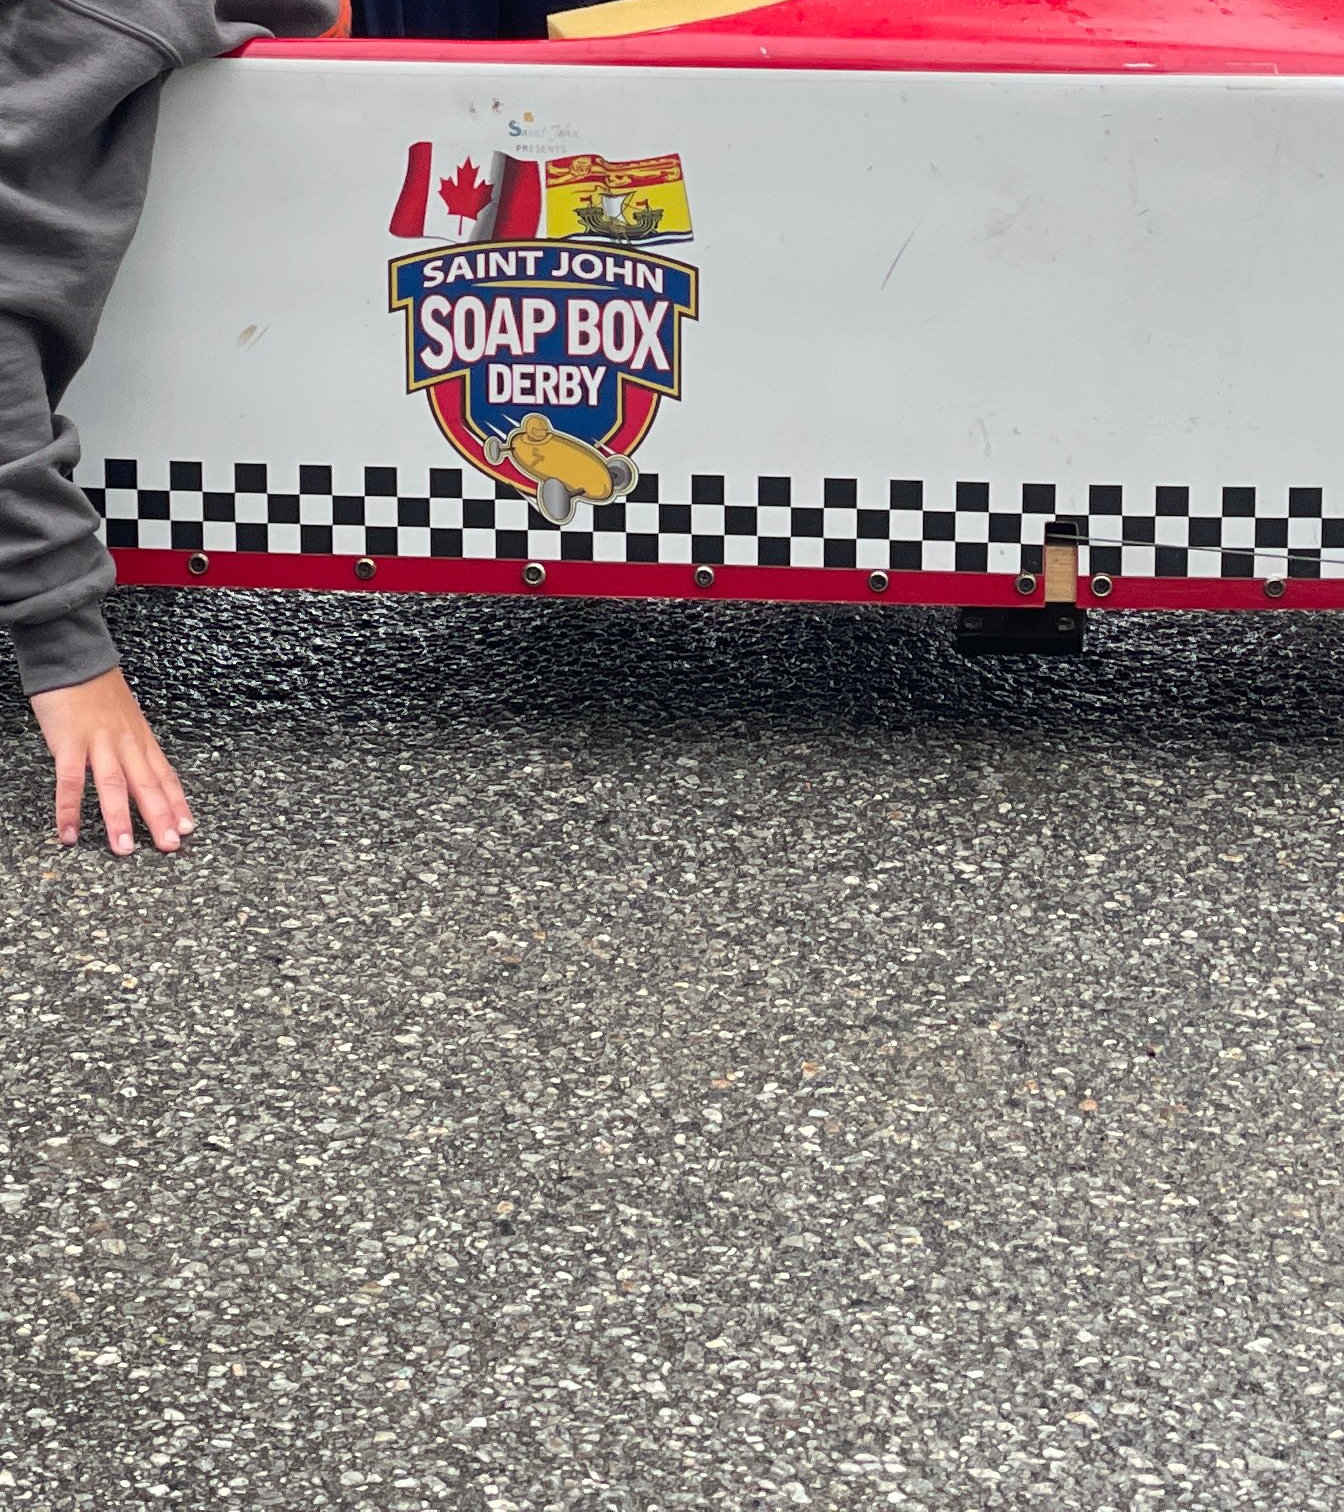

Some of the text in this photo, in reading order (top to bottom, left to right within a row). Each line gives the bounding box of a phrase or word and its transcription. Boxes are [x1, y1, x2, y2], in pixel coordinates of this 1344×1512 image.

[423, 250, 664, 294] SAINT JOHN
[420, 294, 670, 371] SOAP BOX
[488, 364, 606, 406] DERBY
